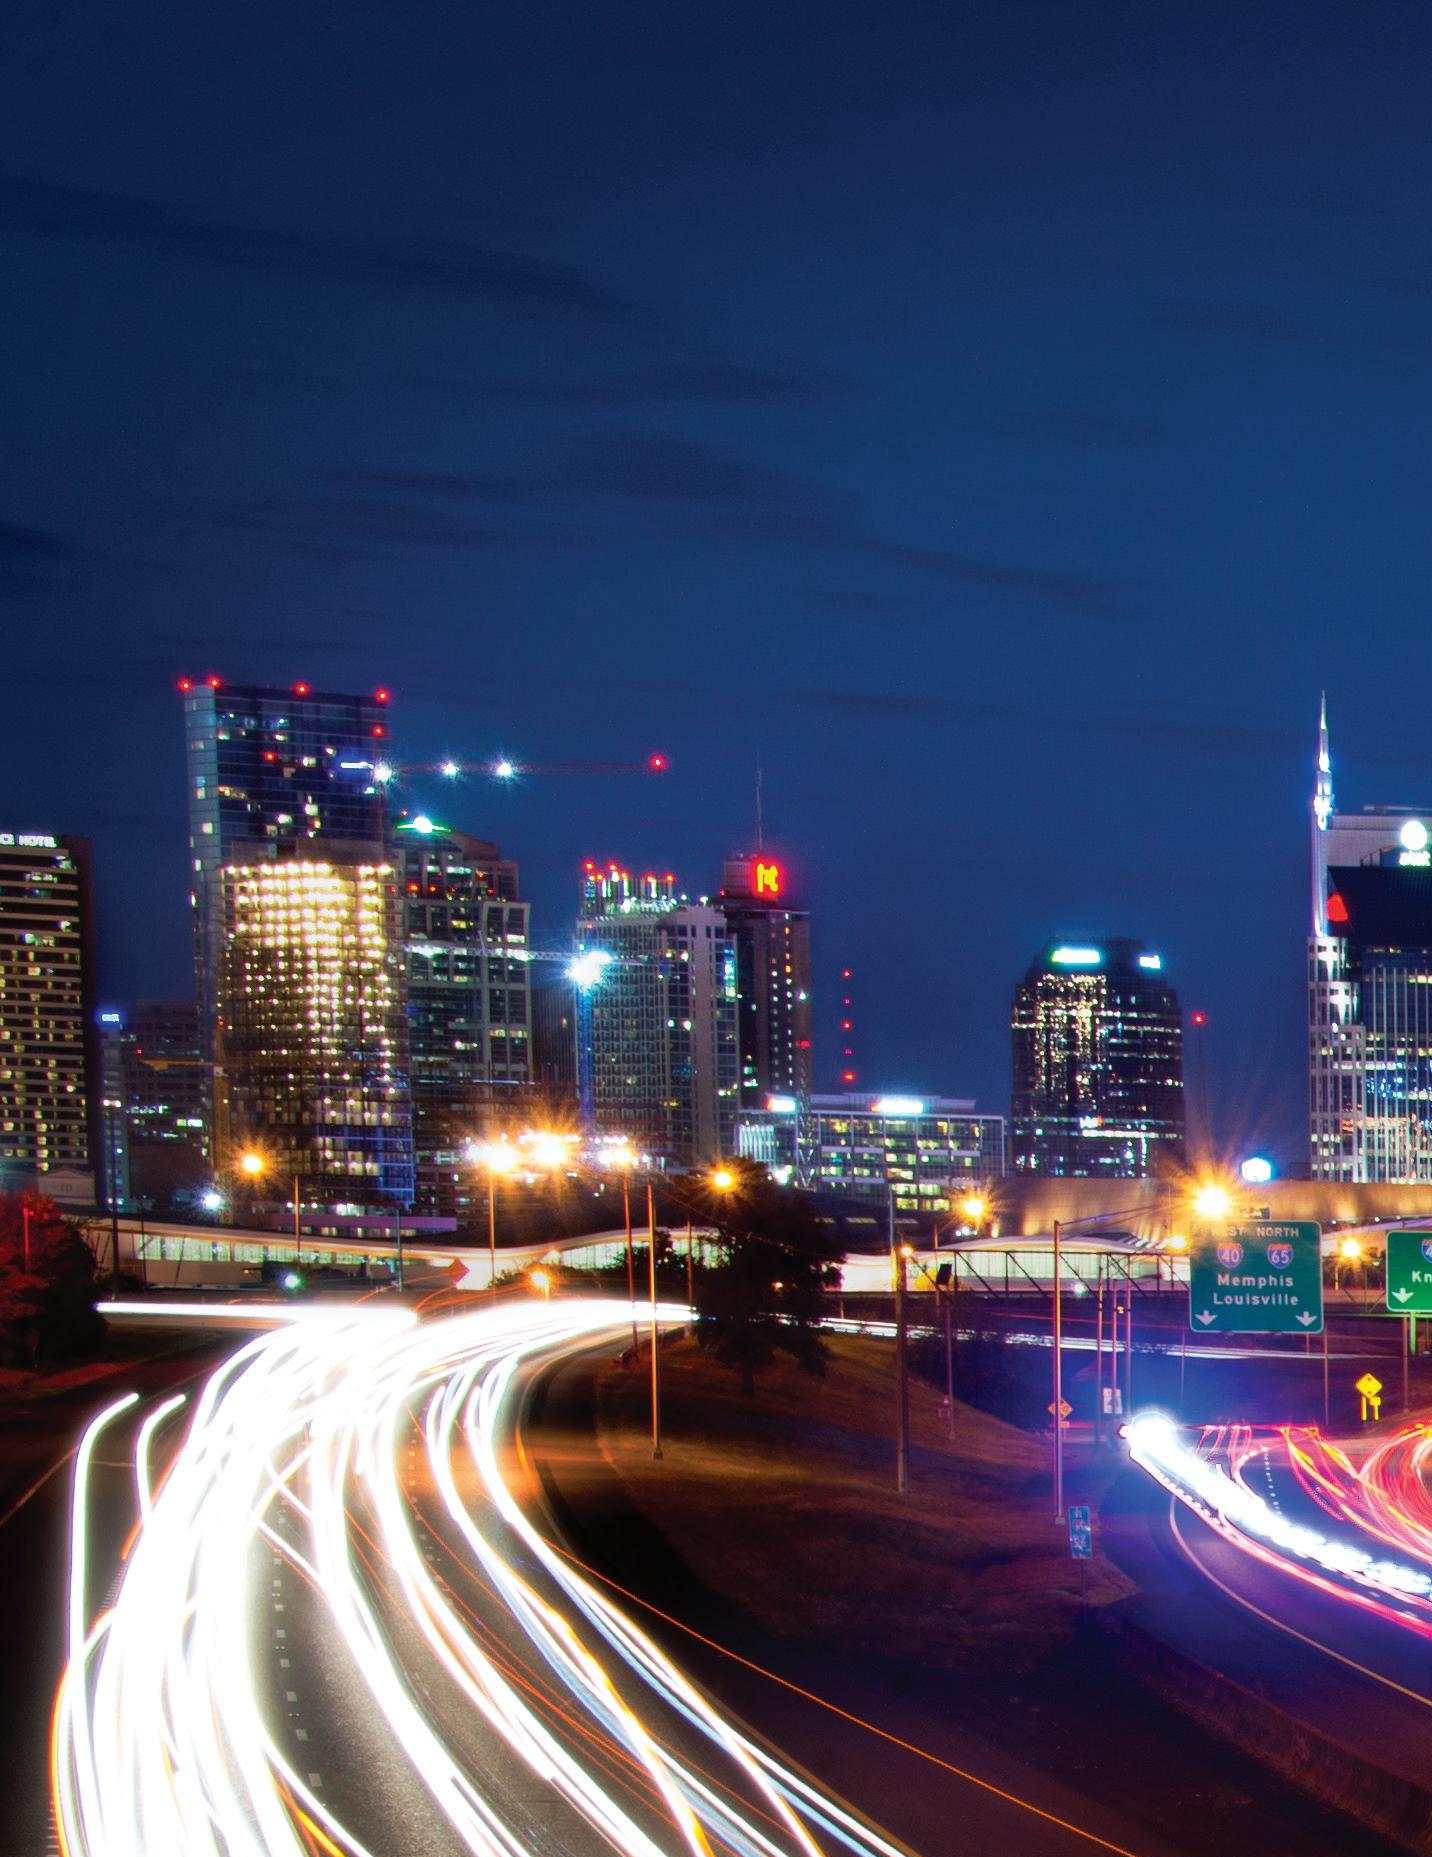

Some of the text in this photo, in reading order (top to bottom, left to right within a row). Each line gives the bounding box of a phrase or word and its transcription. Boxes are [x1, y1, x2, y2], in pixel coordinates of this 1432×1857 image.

[19, 834, 57, 848] HOTEL
[1256, 1226, 1299, 1238] NORTH
[1221, 1248, 1290, 1264] 40 65
[1216, 1273, 1294, 1289] Memphis
[1212, 1292, 1299, 1306] Louisville
